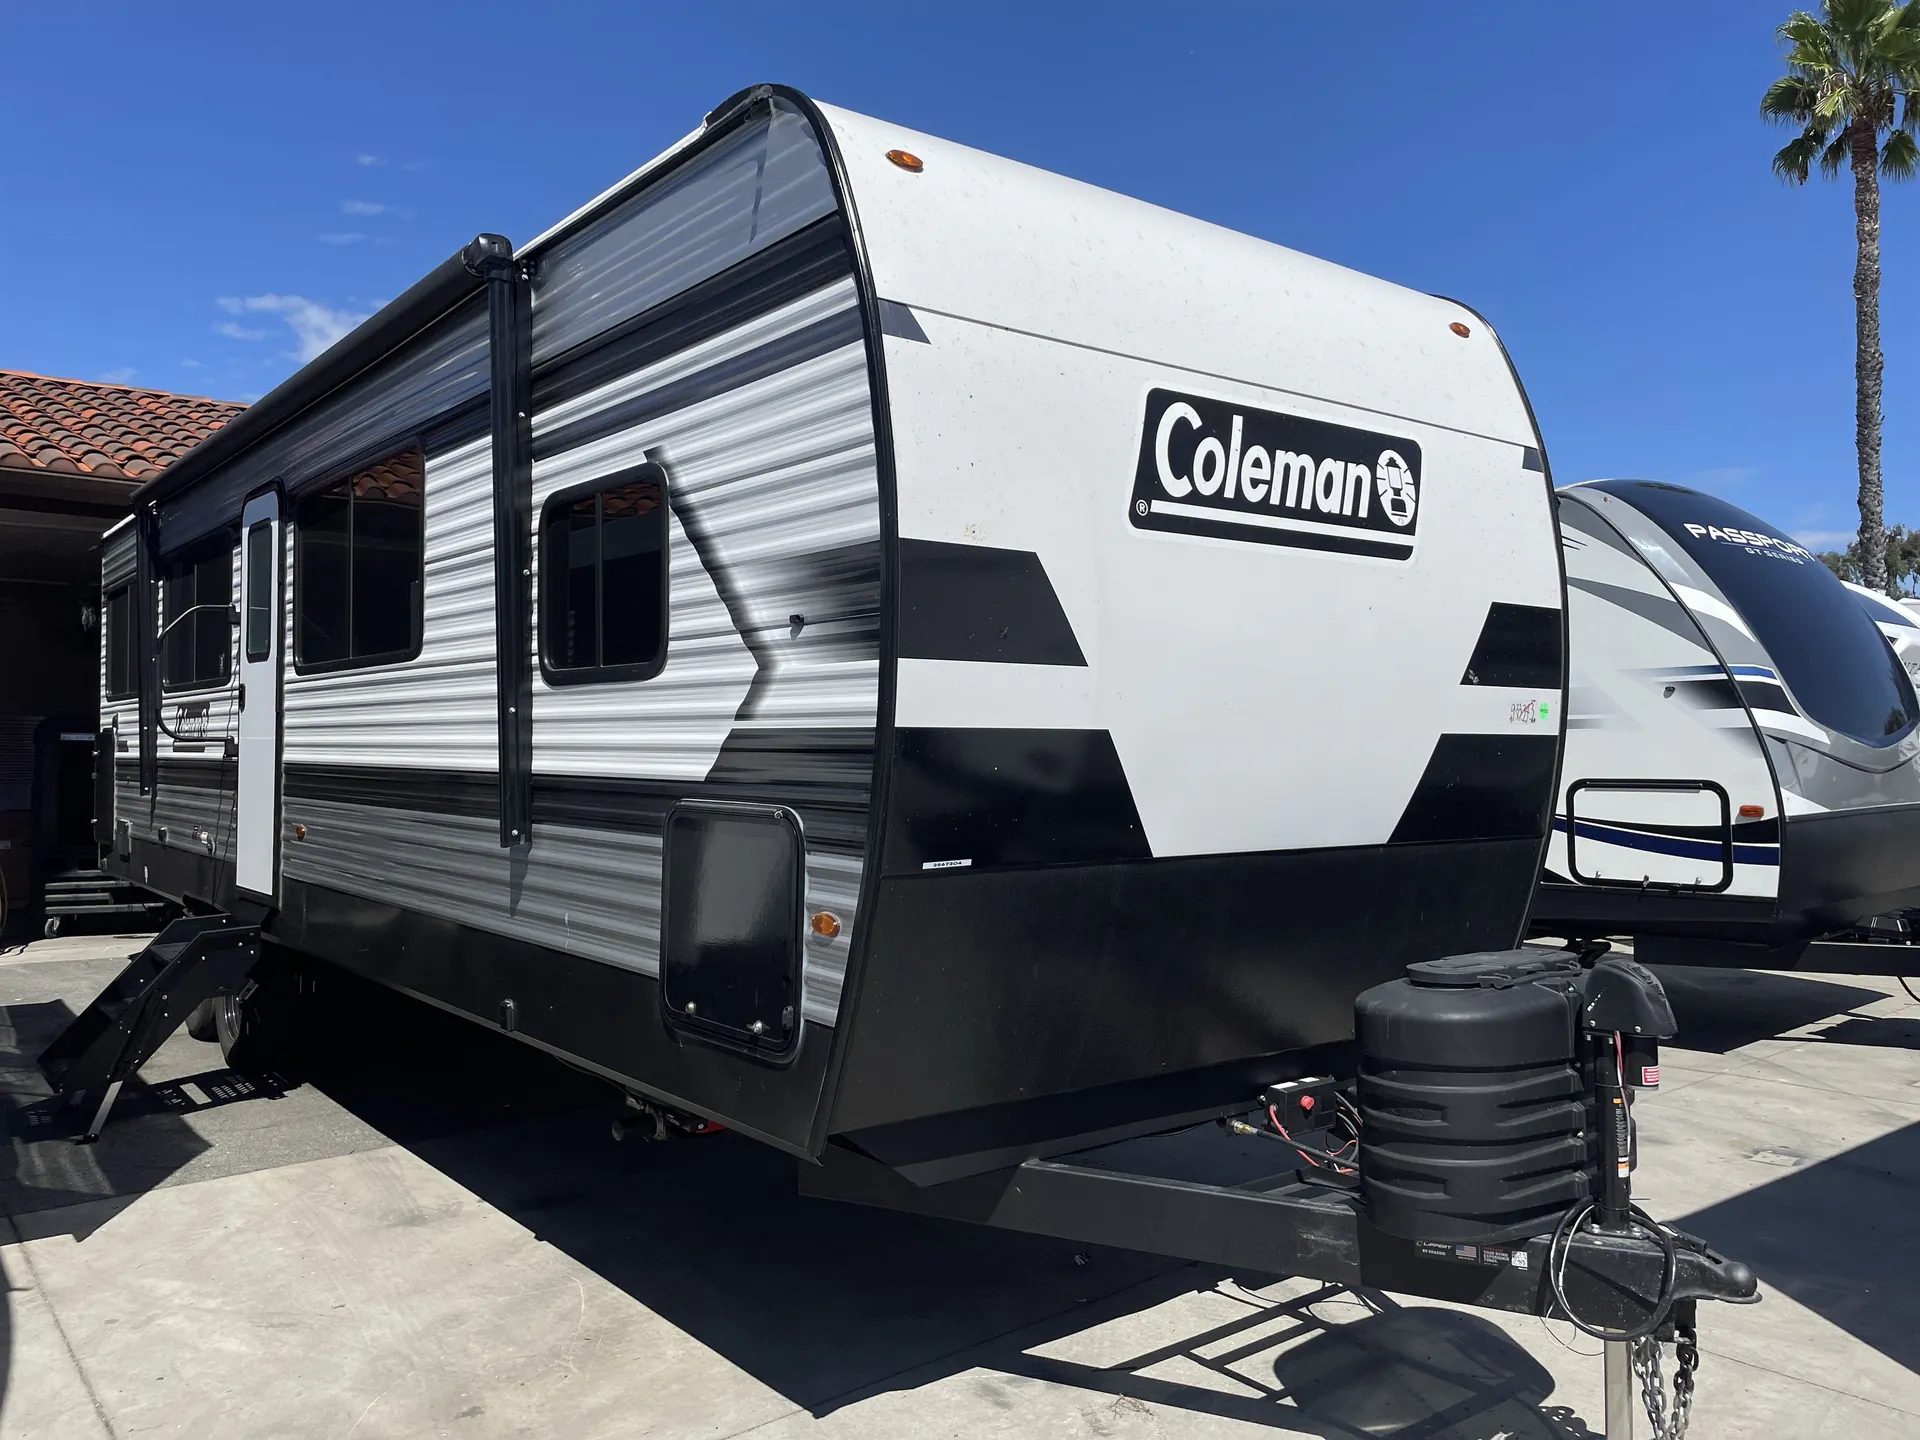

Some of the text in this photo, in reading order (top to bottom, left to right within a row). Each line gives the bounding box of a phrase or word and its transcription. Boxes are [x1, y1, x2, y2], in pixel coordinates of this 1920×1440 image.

[1155, 401, 1372, 518] Coleman
[1683, 523, 1816, 562] PASSPORT
[1745, 547, 1805, 565] GT SERIES
[1423, 1242, 1452, 1250] LIPPERT
